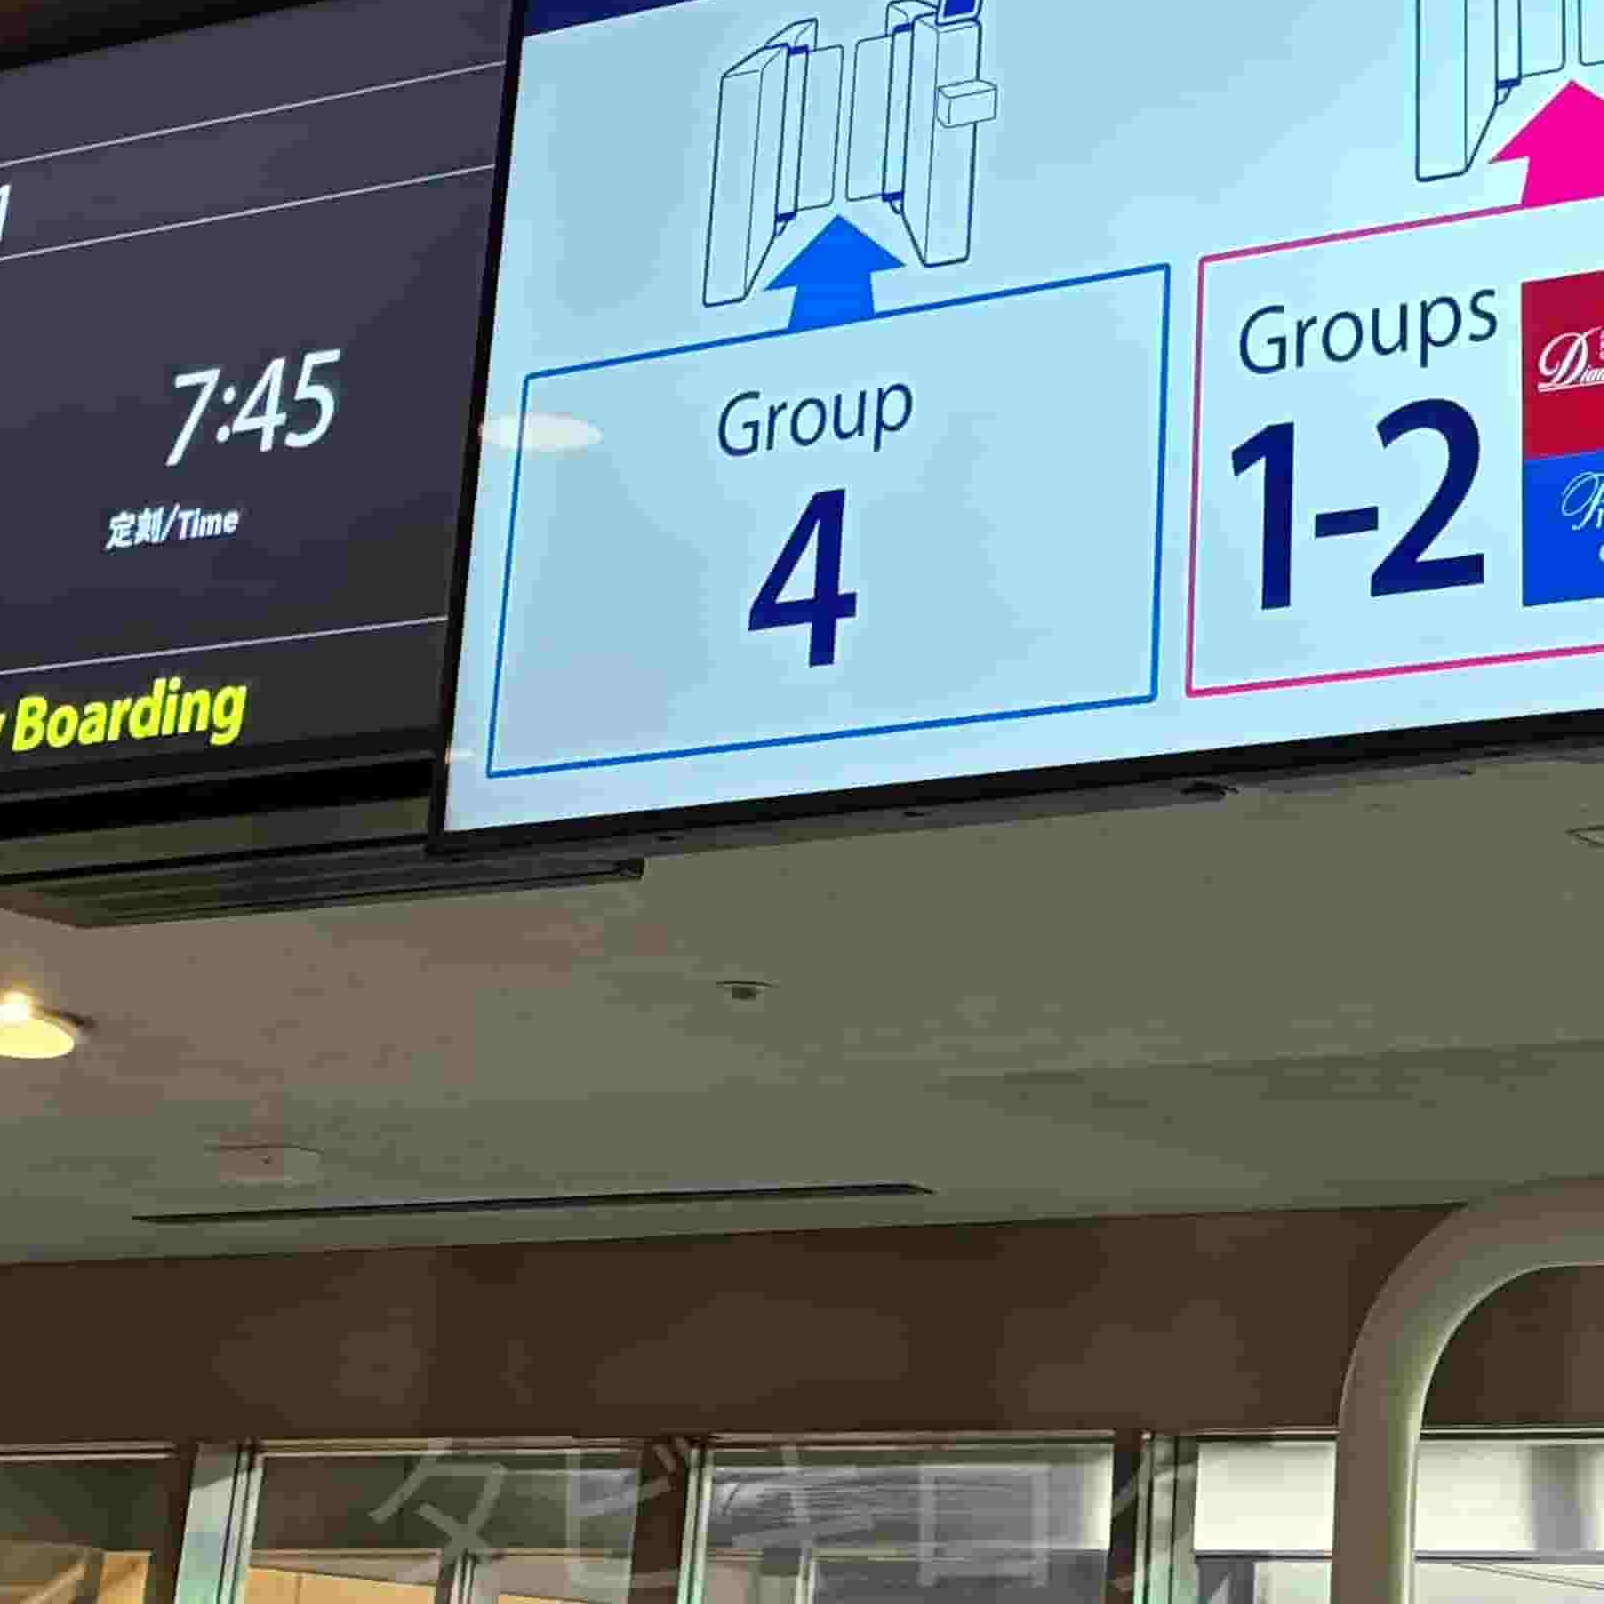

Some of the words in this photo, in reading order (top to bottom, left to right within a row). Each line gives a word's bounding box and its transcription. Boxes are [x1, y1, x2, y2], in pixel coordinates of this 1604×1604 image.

[1239, 288, 1499, 375] Groups
[164, 348, 342, 467] 7:45
[717, 381, 914, 457] Group
[1231, 398, 1485, 612] 1-2
[747, 489, 858, 668] 4
[11, 678, 248, 752] Boarding
